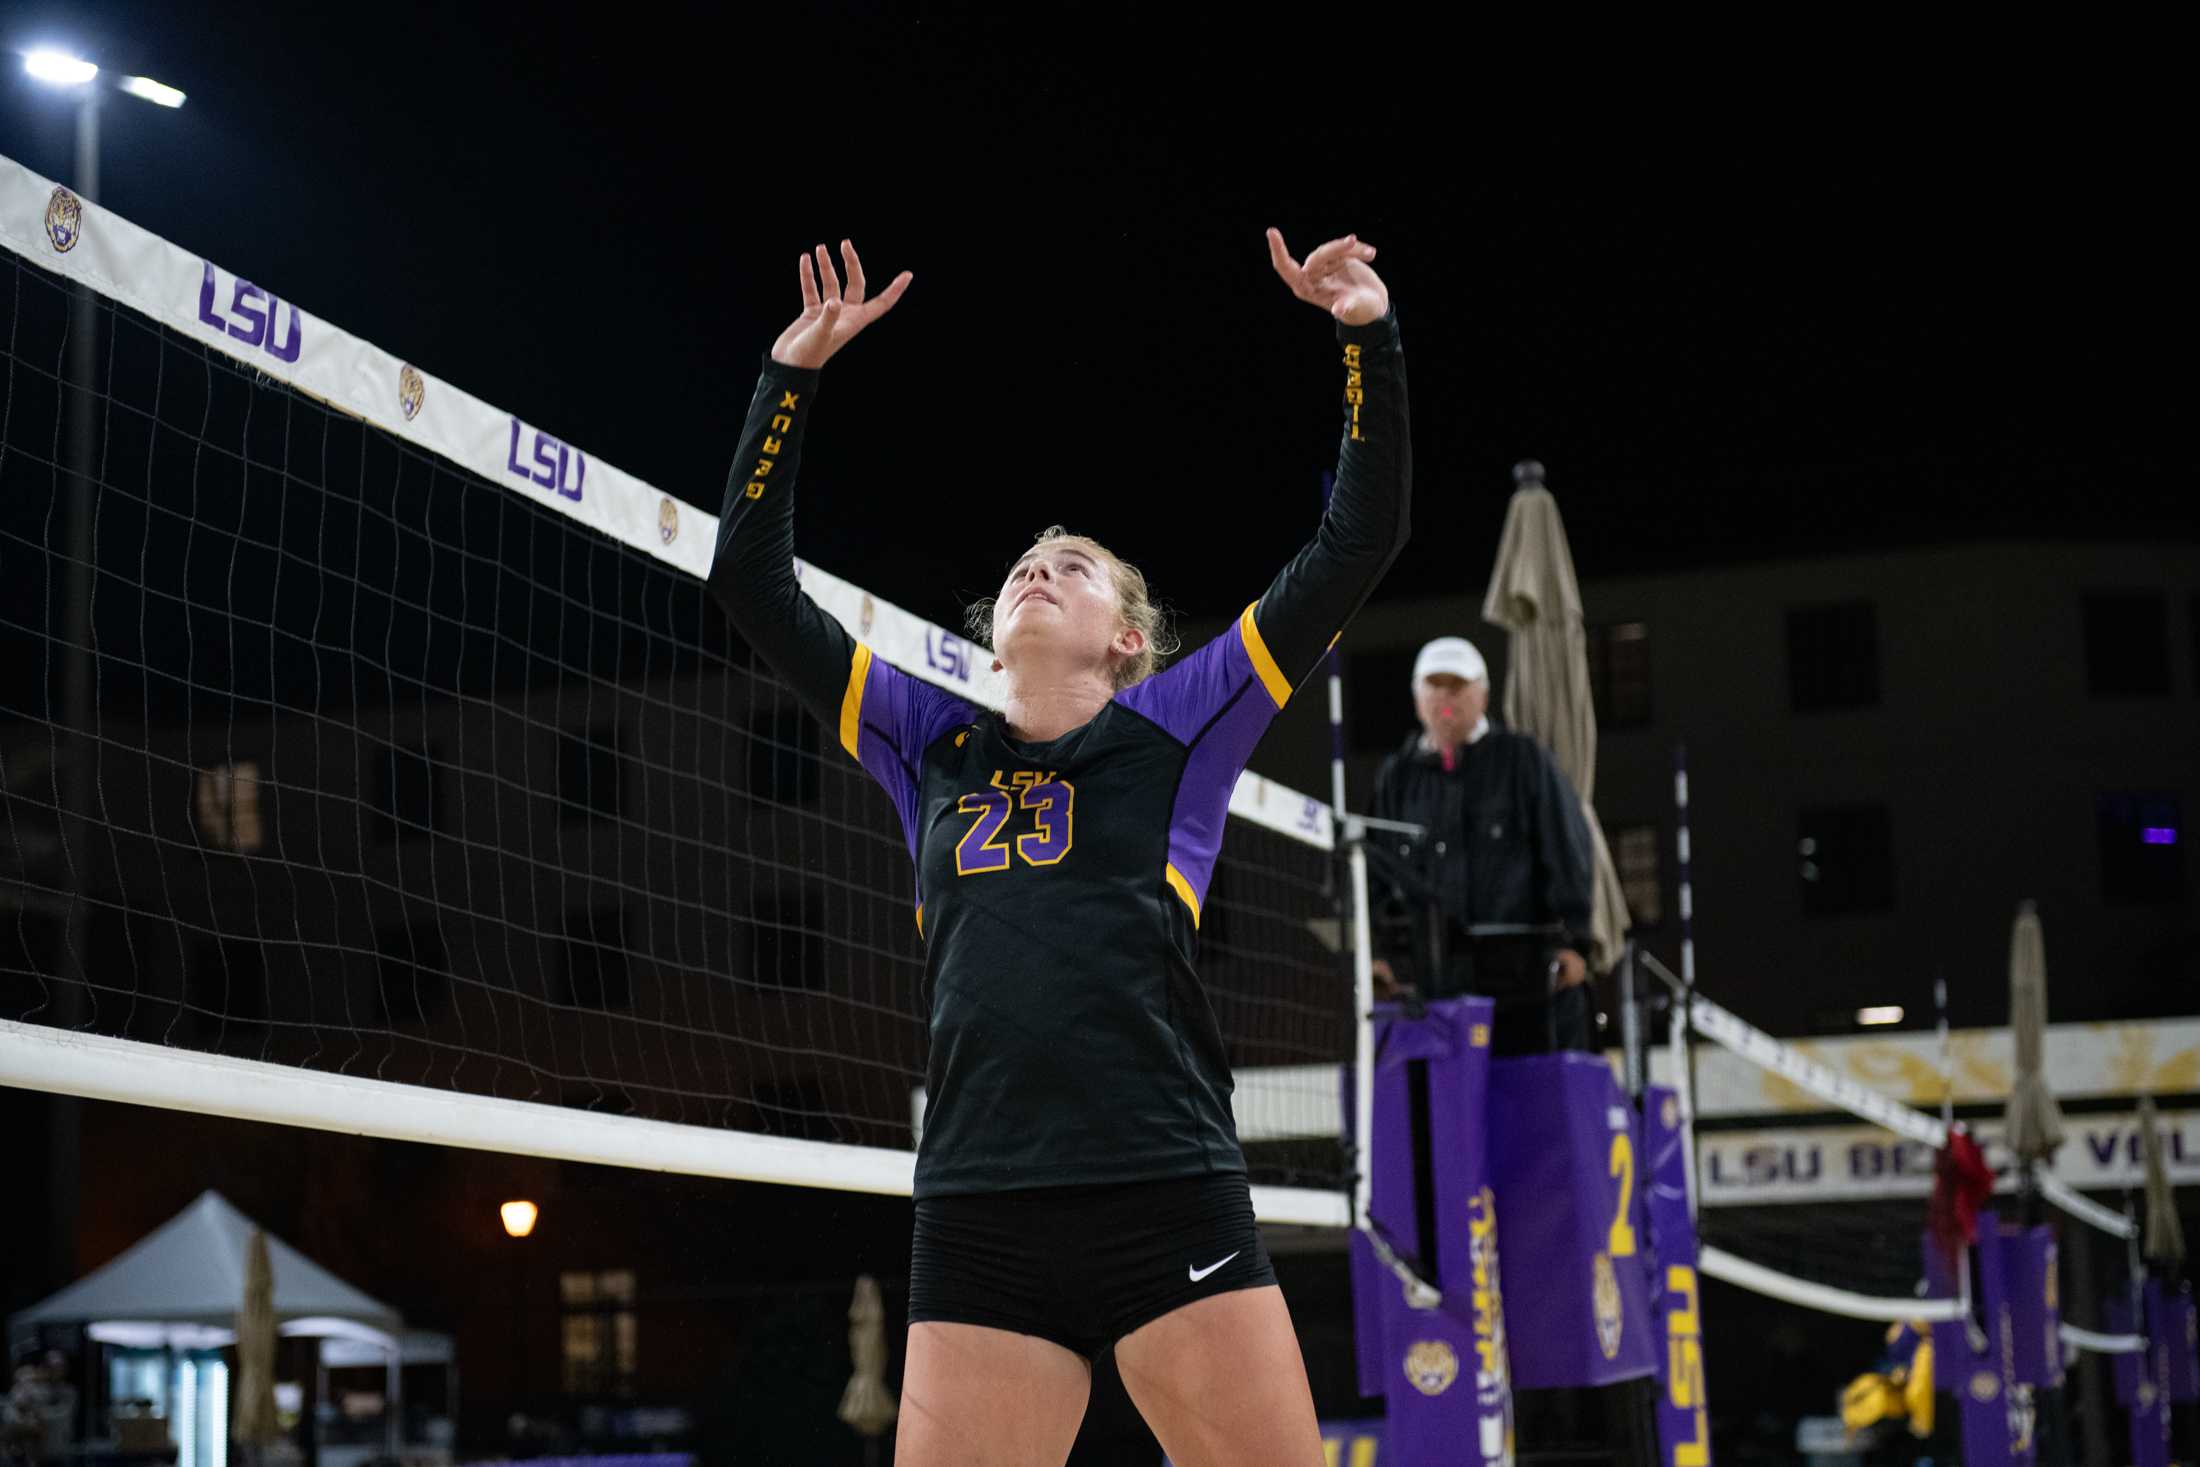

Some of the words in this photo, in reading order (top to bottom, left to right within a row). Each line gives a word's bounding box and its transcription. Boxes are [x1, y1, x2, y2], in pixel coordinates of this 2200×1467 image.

[199, 260, 301, 363] LSU
[508, 415, 585, 502] LSU
[926, 628, 972, 682] LSU
[990, 769, 1057, 790] LSU
[955, 779, 1075, 877] 23
[1610, 1133, 1636, 1256] 2
[1710, 1147, 1818, 1185] LSU
[1667, 1265, 1713, 1467] LSU
